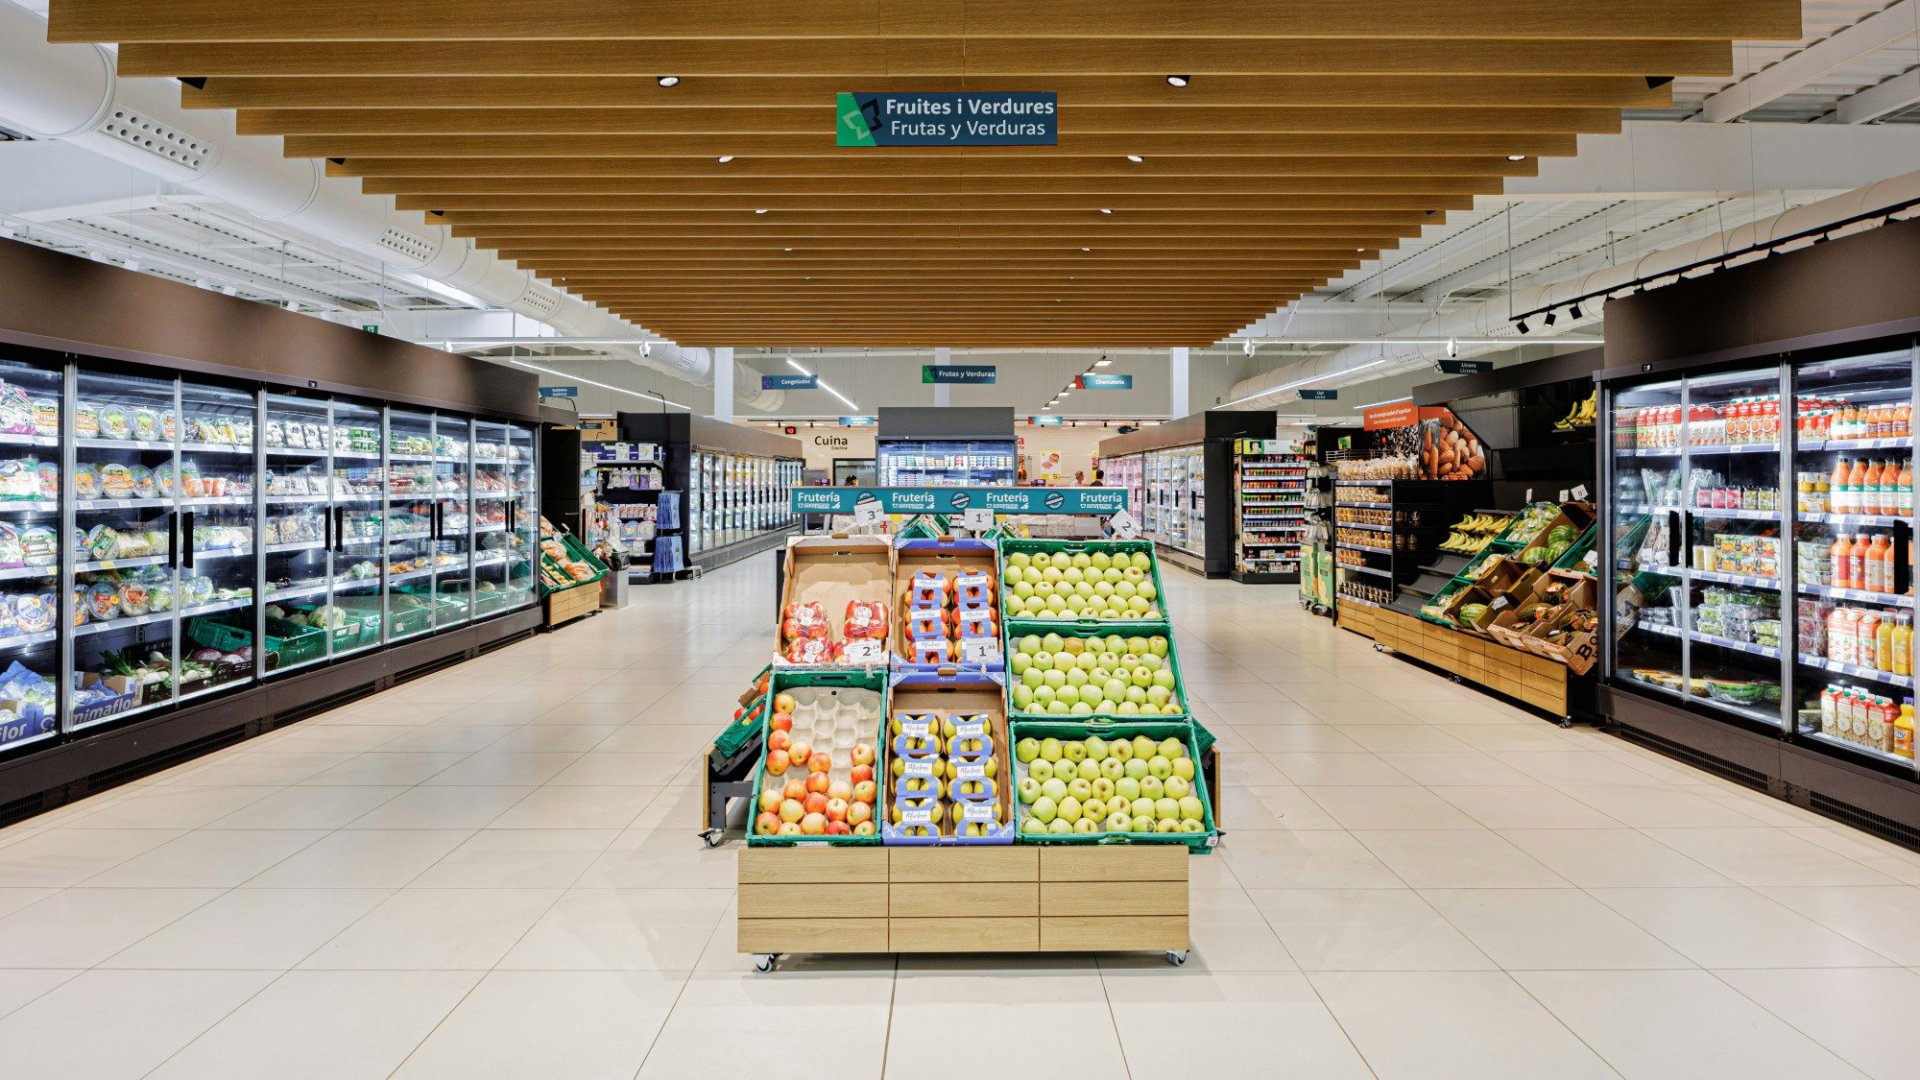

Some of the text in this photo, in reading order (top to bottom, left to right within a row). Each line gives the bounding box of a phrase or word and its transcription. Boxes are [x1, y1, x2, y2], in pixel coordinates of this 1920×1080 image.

[886, 98, 1054, 115] Fruites i Verdures
[891, 119, 1046, 140] Frutas y Verduras
[814, 436, 848, 446] Cuina
[797, 492, 840, 502] Frutería
[892, 492, 935, 502] Frutería
[986, 492, 1029, 502] Frutería
[1080, 492, 1123, 502] Frutería
